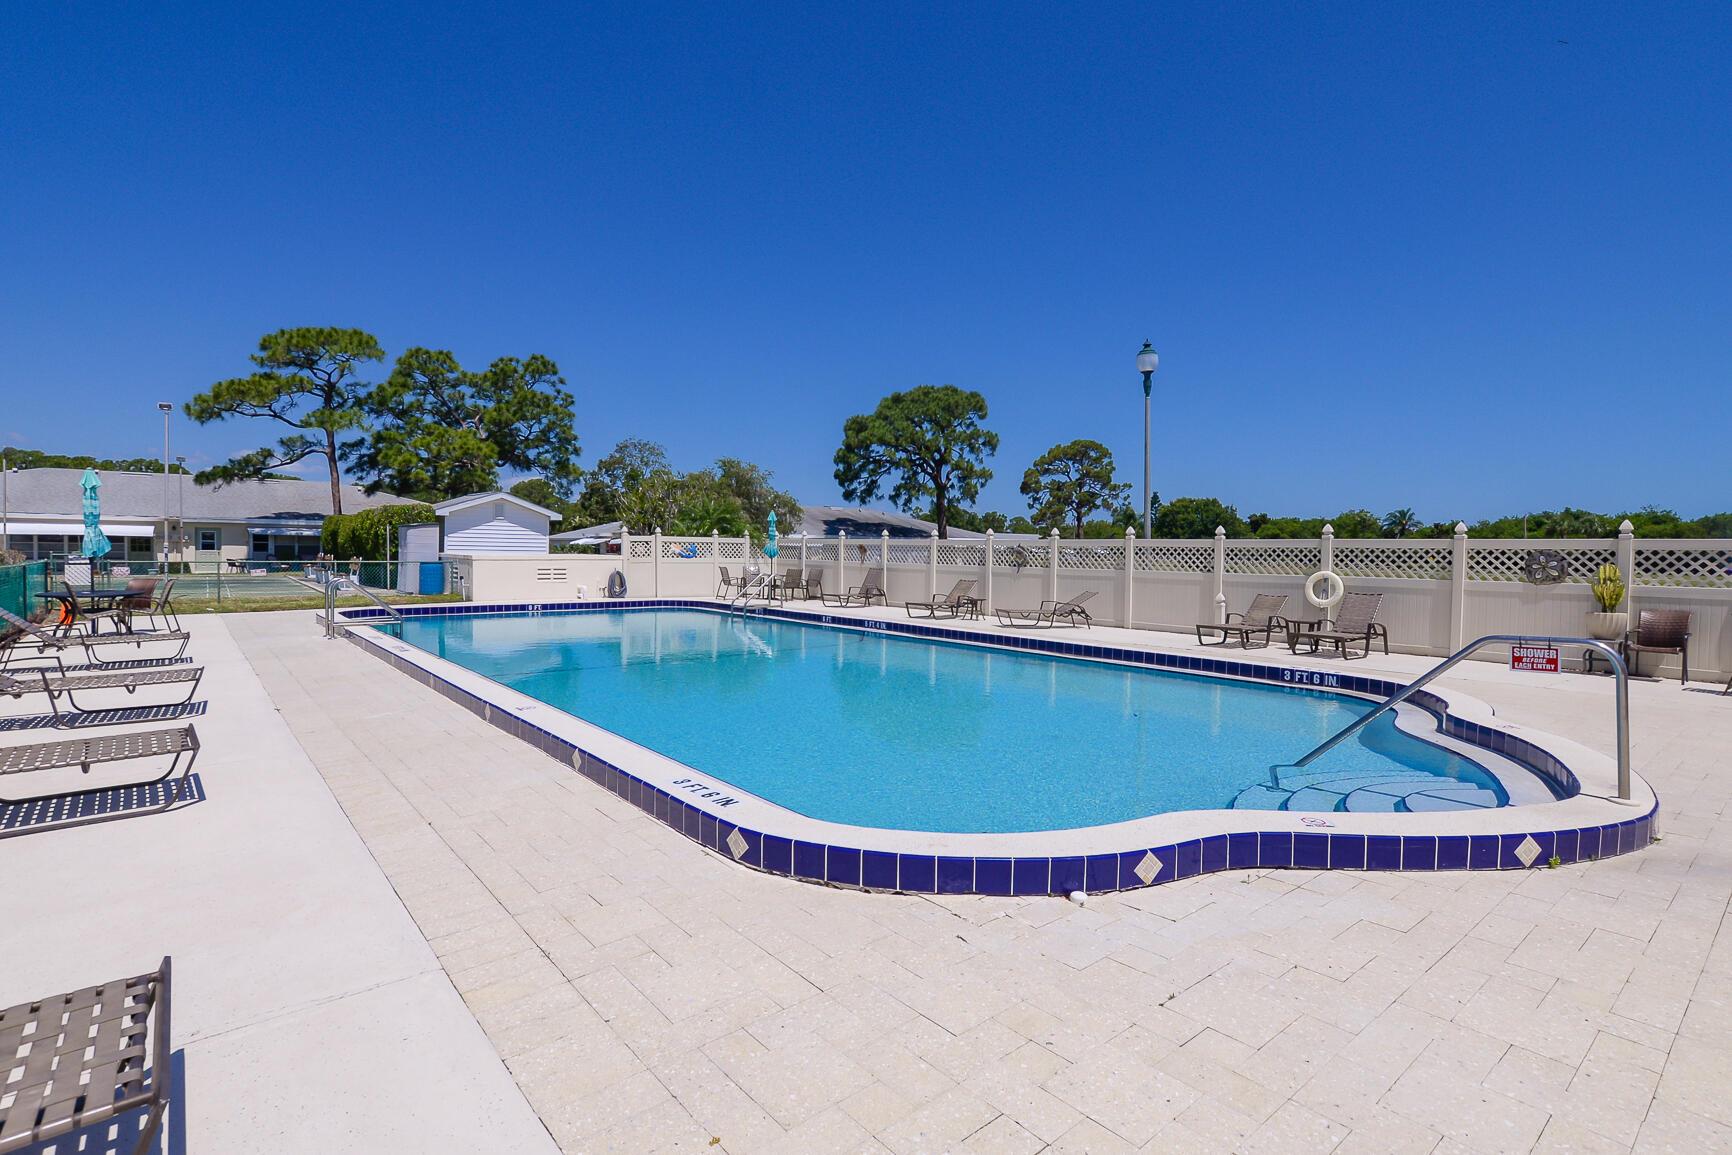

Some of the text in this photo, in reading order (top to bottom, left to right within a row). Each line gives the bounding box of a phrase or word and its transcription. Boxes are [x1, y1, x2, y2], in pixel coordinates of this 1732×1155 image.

[1513, 647, 1557, 659] SHOWER
[1284, 670, 1291, 681] 3
[1313, 673, 1321, 685] 6
